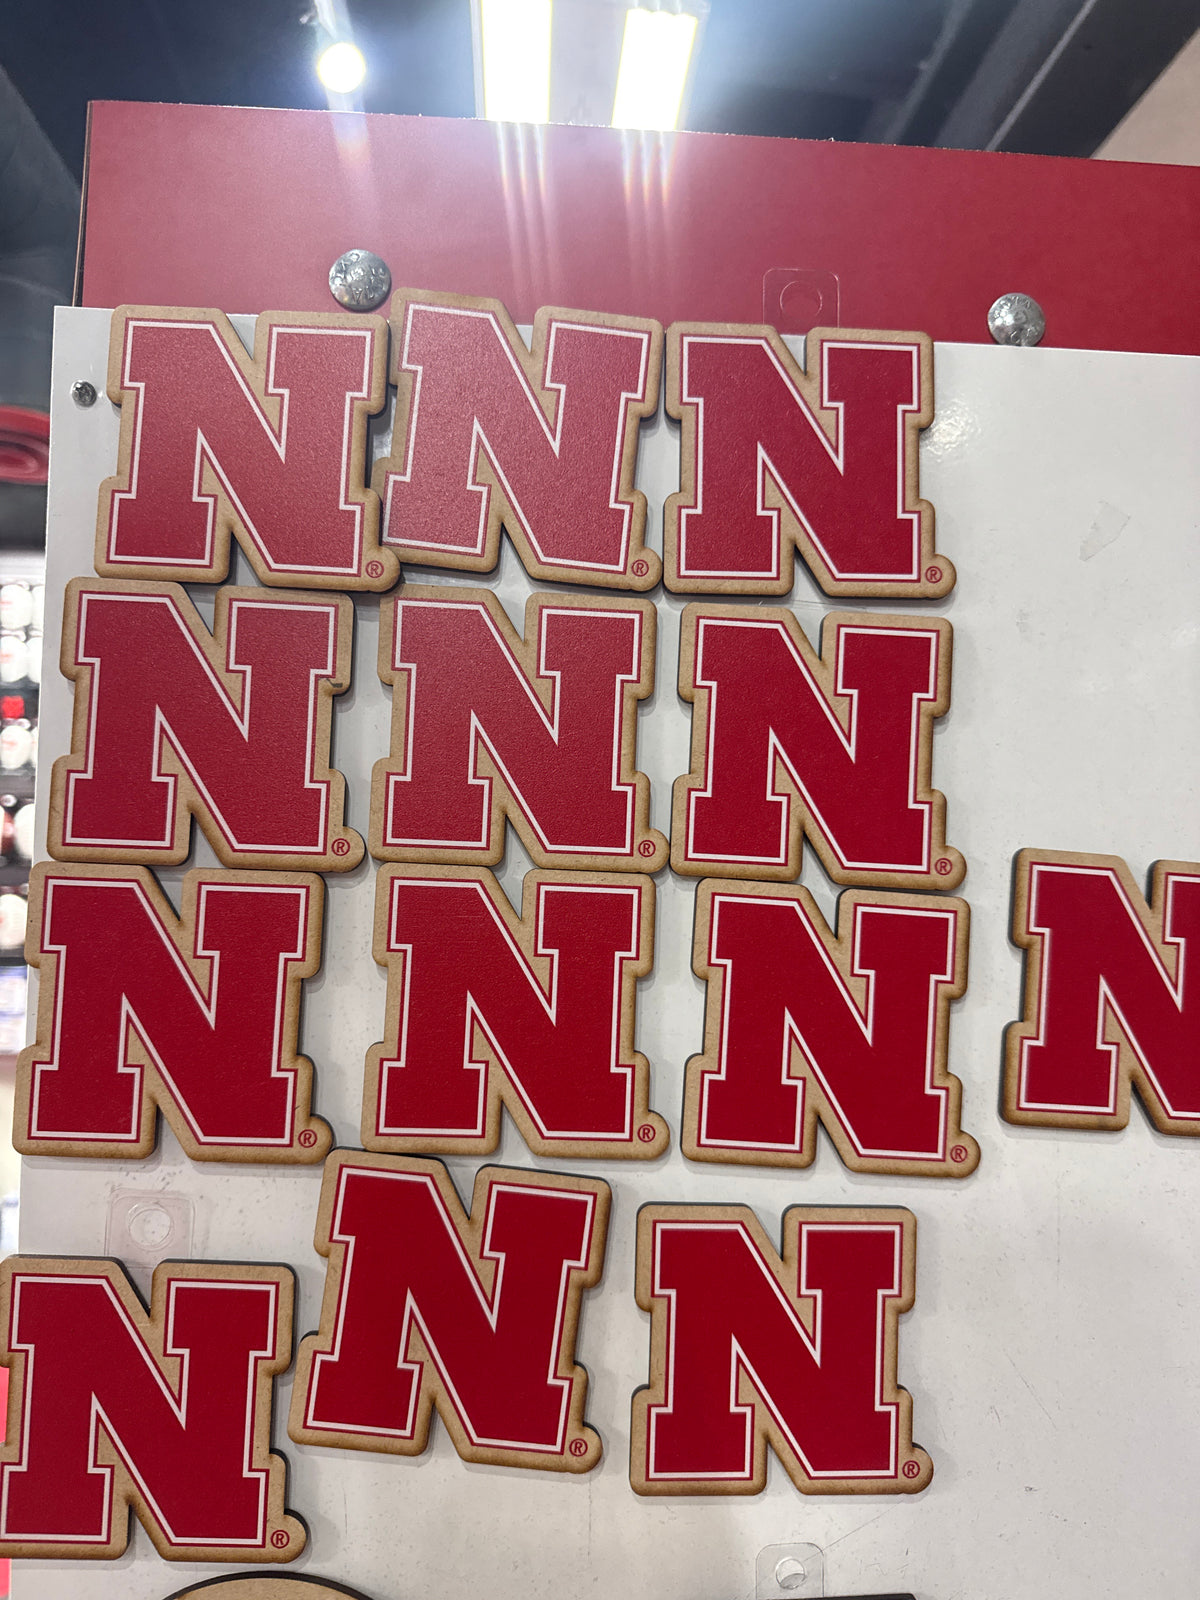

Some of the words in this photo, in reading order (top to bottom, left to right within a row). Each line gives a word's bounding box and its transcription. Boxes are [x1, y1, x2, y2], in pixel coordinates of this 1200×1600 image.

[106, 318, 374, 577] N
[382, 303, 652, 574] N
[677, 334, 921, 583] N
[62, 590, 339, 856] N
[382, 597, 643, 856] N
[684, 616, 940, 875] N
[27, 875, 309, 1148] N
[375, 876, 642, 1142] N
[696, 892, 957, 1162] N
[0, 1272, 279, 1548] N
[303, 1164, 597, 1455] N
[645, 1219, 903, 1482] N
